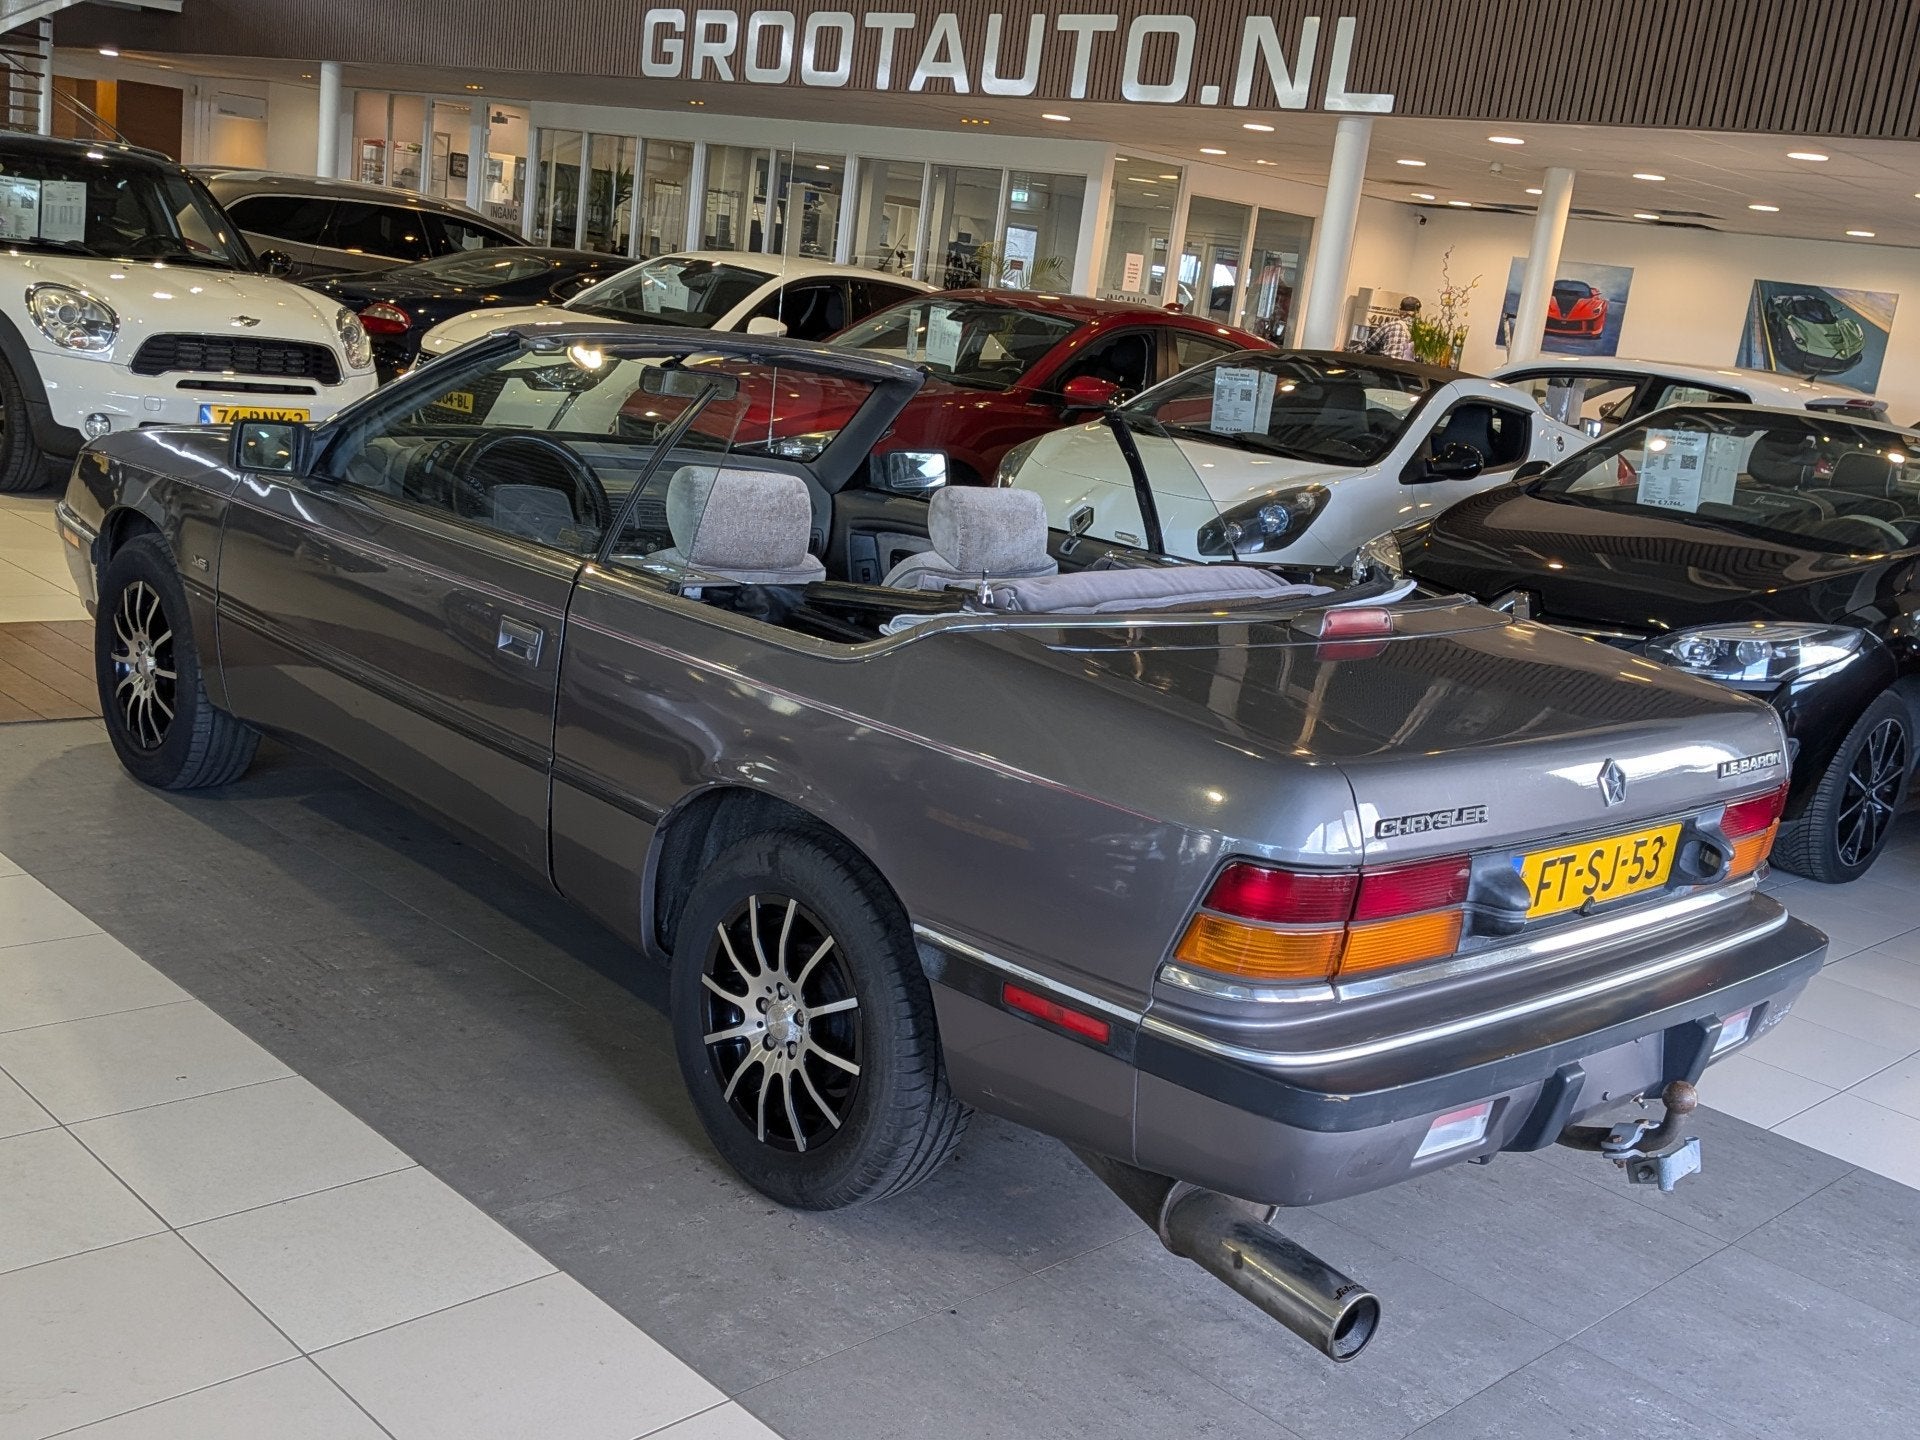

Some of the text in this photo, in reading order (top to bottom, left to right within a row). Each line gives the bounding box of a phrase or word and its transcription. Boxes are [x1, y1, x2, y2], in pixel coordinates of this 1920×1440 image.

[641, 8, 1395, 113] GROOTAUTO.NL
[490, 205, 518, 221] INGANG
[1375, 804, 1489, 839] CHRYSLER
[1533, 835, 1666, 907] FT-SJ-53
